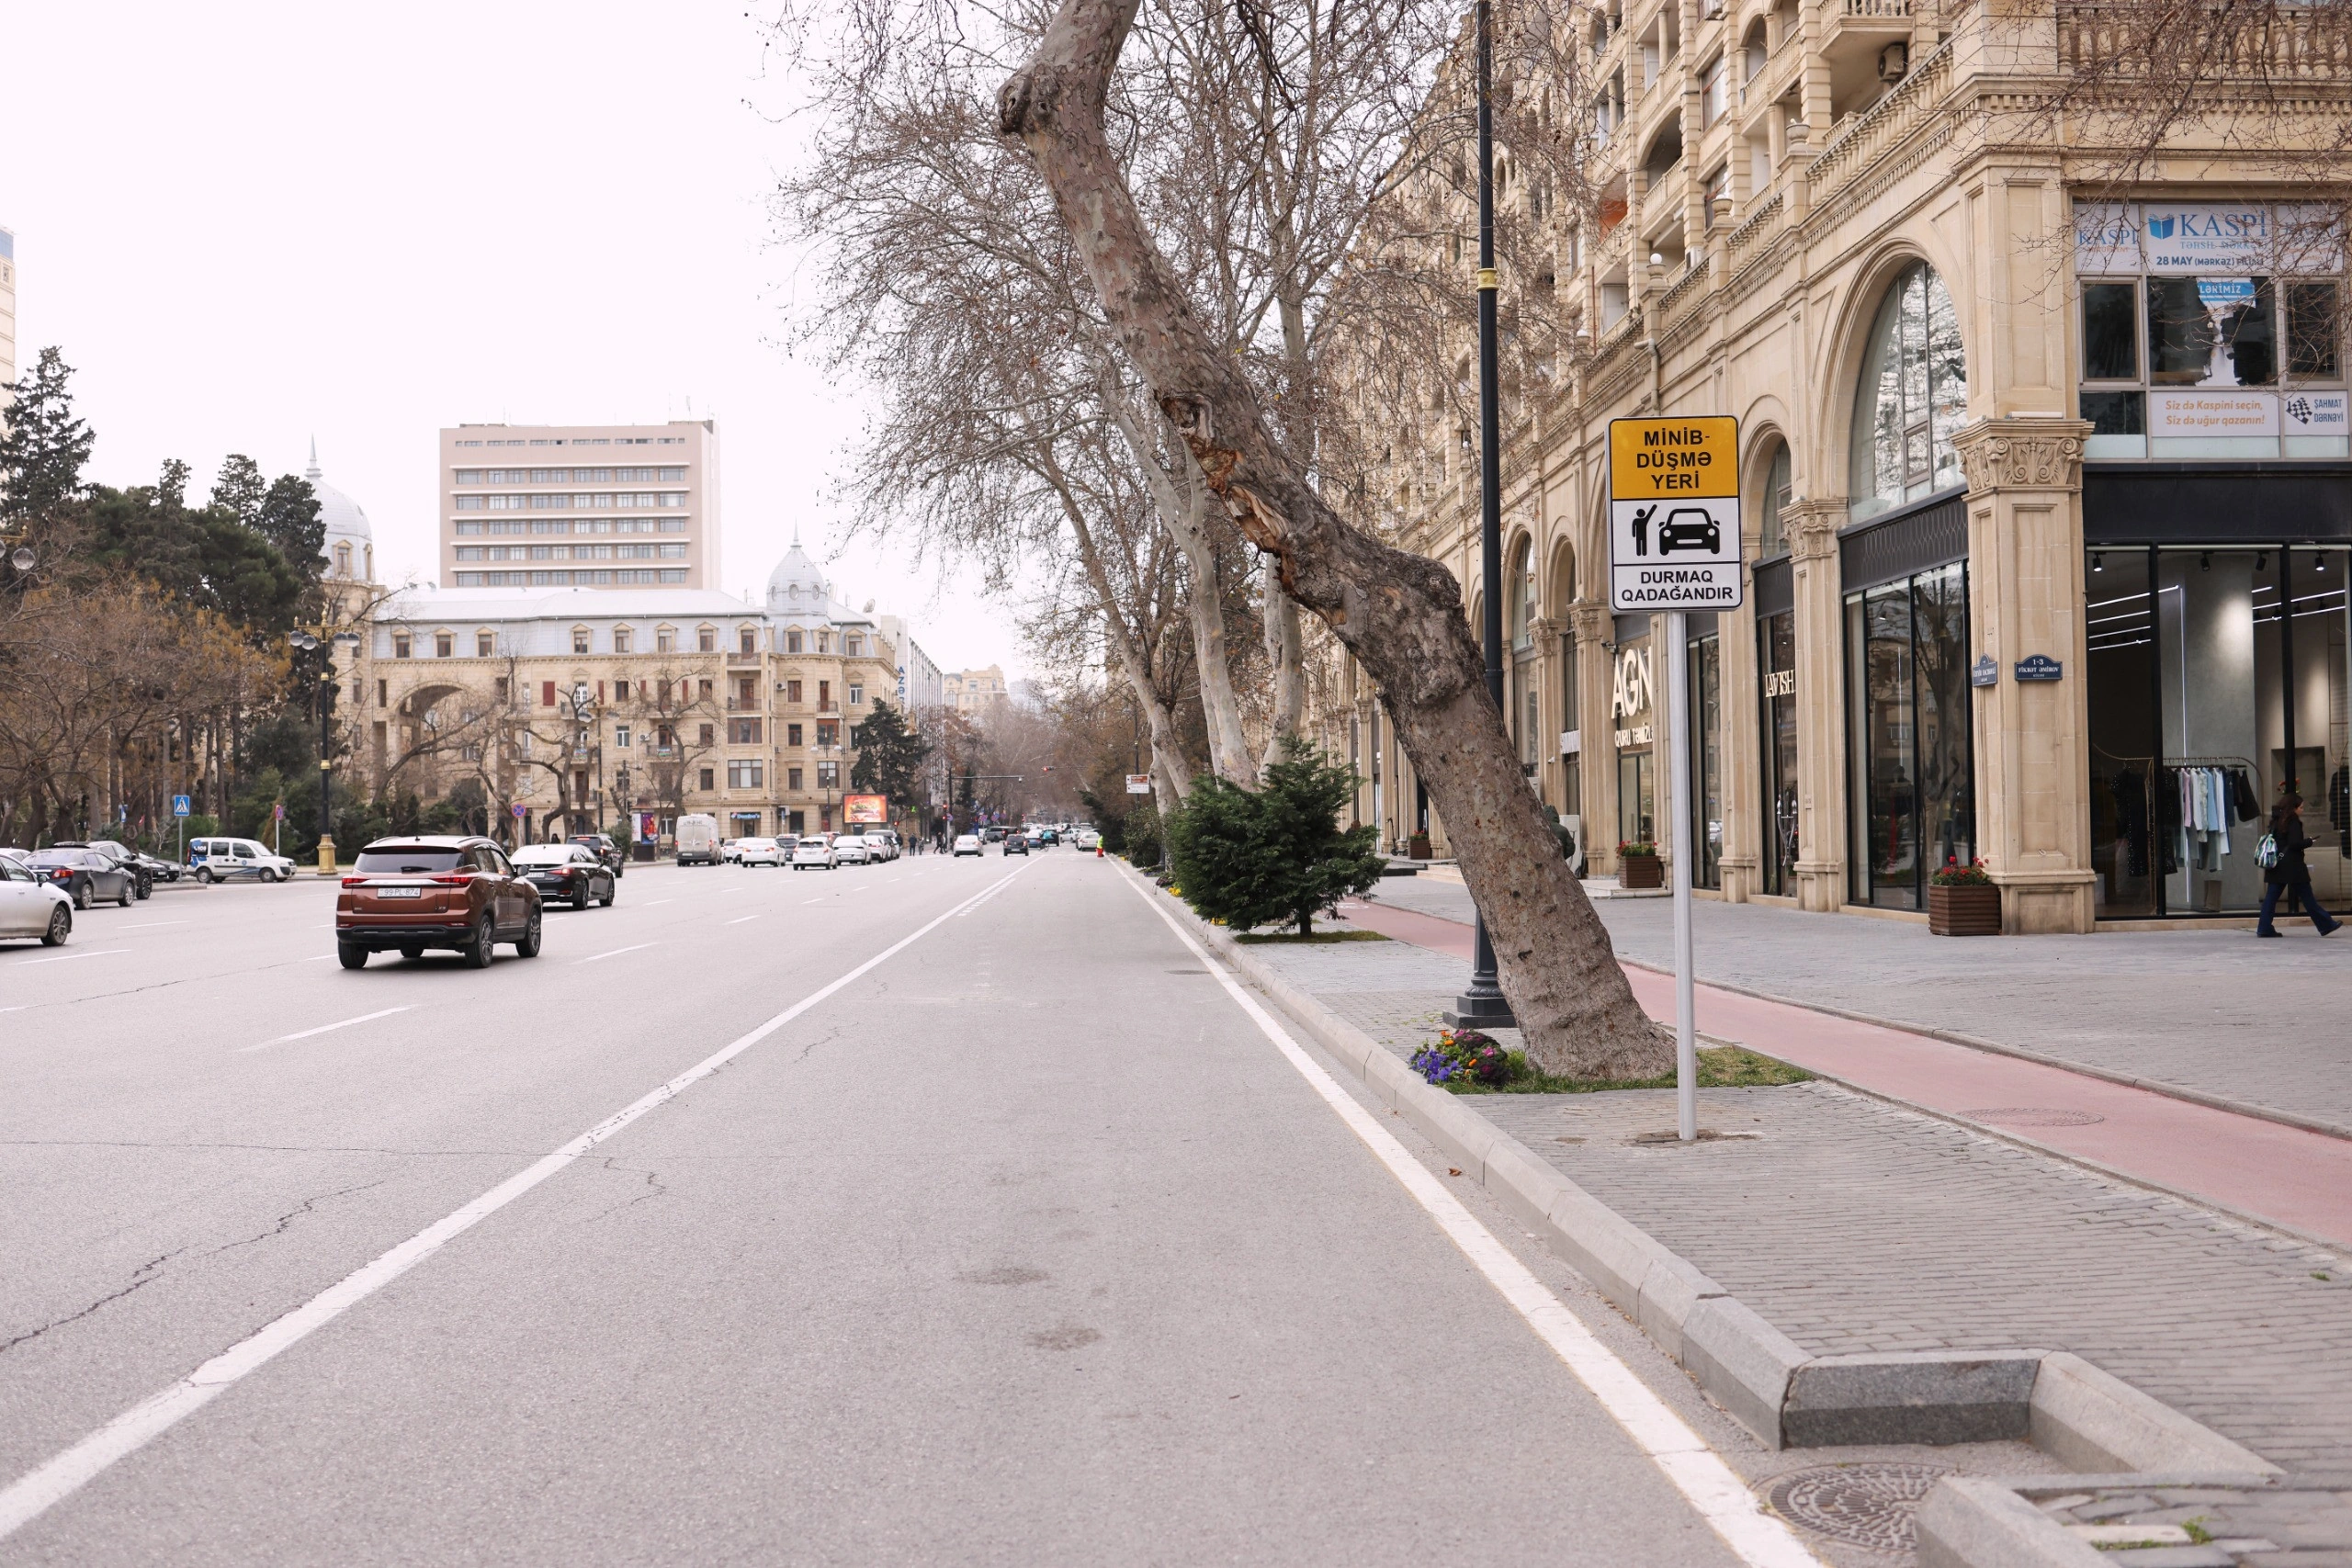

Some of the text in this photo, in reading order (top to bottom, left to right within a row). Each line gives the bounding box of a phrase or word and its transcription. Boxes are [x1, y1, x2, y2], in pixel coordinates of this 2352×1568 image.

[2155, 256, 2169, 265] 28
[2171, 256, 2193, 265] MAY
[2194, 257, 2234, 266] (MƏRKƏZ)
[2165, 400, 2263, 412] Siz də Kaspini seçin,
[2313, 399, 2342, 410] ŞAHMAT
[2165, 414, 2265, 427] Siz də uğur qazanın!
[2313, 412, 2344, 423] DƏRNƏYİ
[1644, 426, 1711, 446] MİNİB-
[1636, 450, 1713, 470] DÜŞMƏ
[1651, 469, 1700, 490] YERİ
[1640, 570, 1713, 584] DURMAQ
[1621, 585, 1734, 603] QADAĞANDIR
[1614, 729, 1631, 748] QURU
